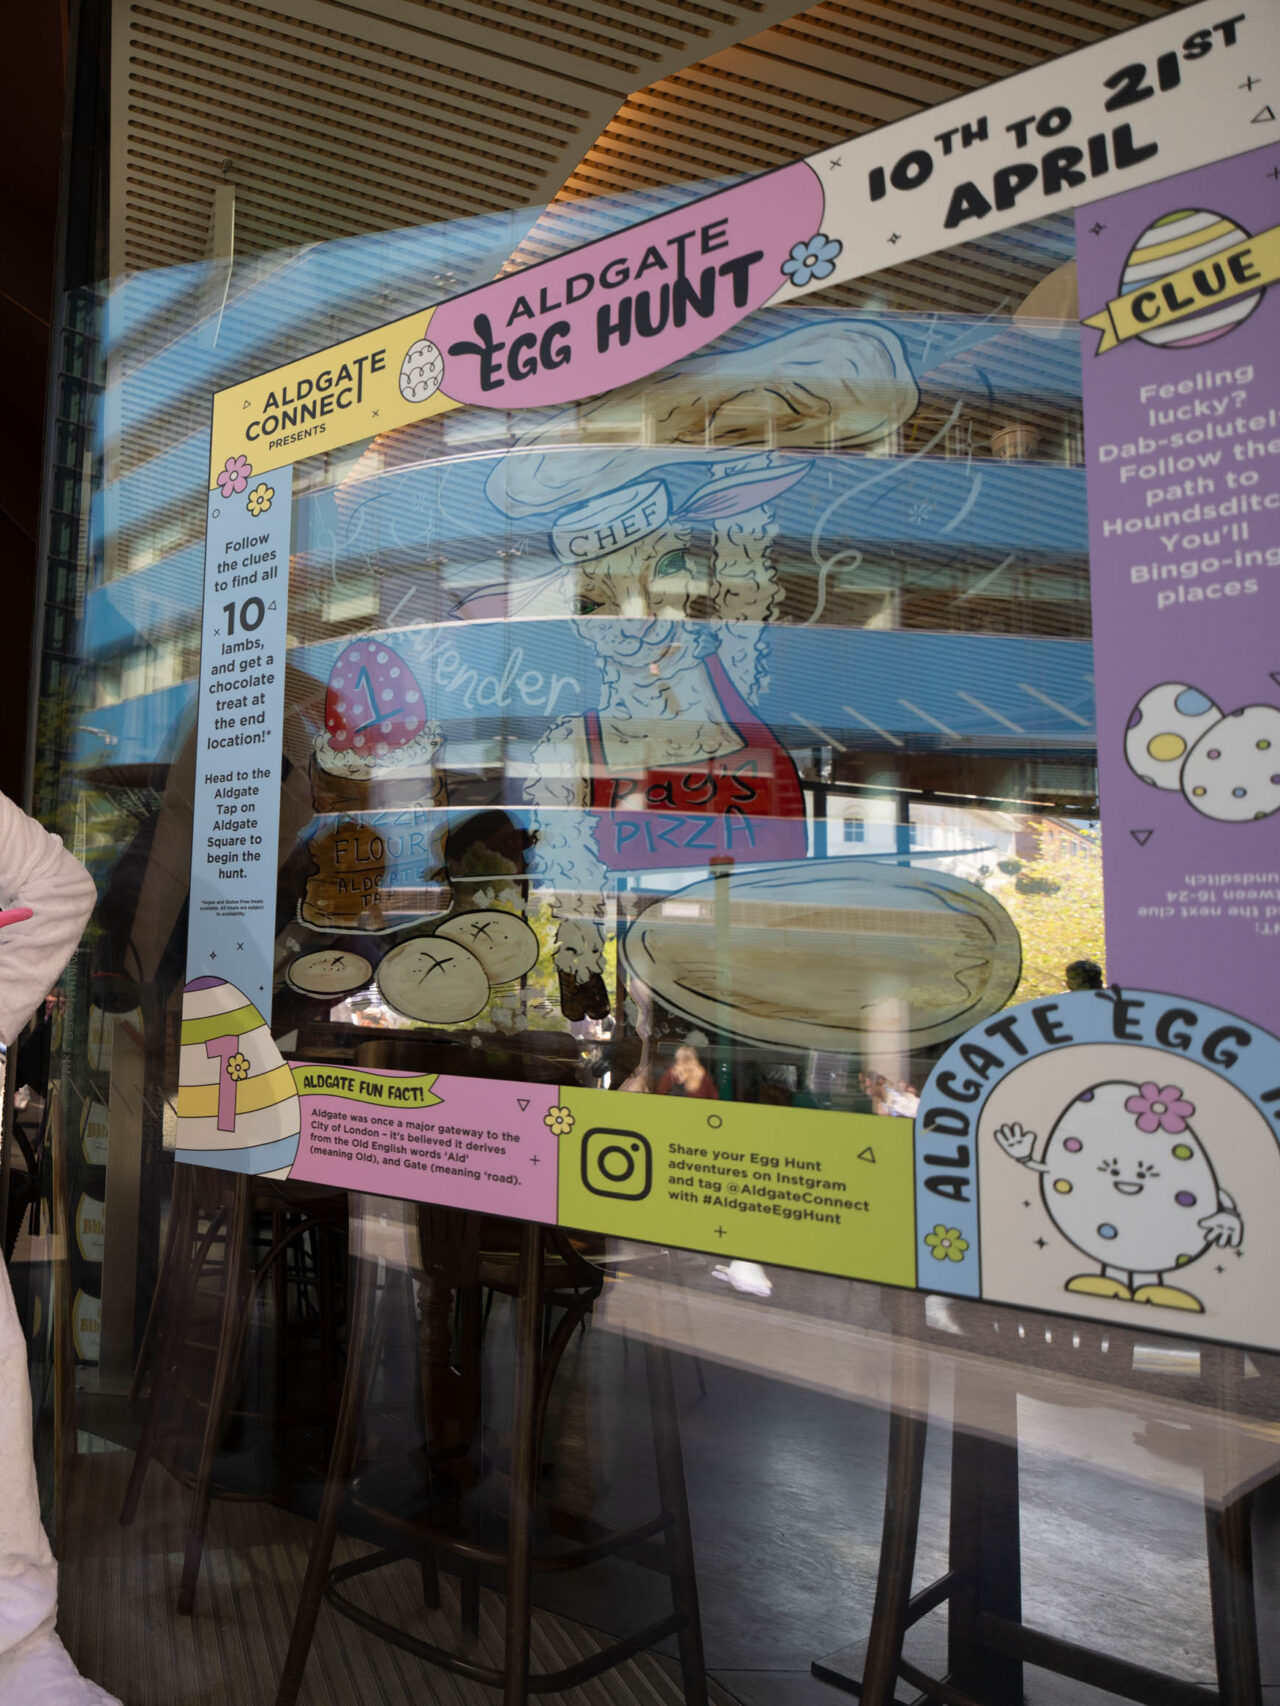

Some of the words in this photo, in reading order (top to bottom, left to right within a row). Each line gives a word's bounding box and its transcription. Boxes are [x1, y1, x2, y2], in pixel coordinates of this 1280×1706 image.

[869, 117, 988, 201] 10TH
[1006, 106, 1072, 149] TO
[1104, 14, 1247, 111] 21ST
[944, 123, 1158, 228] APRIL
[506, 218, 739, 327] ALDGATE
[1131, 249, 1261, 326] CLUE
[460, 314, 572, 392] EGG
[596, 250, 764, 353] HUNT
[263, 349, 386, 413] ALDGATE
[1140, 365, 1254, 403] Feeling
[245, 386, 363, 441] CONNECT
[1149, 390, 1247, 427] lucky?
[268, 423, 326, 450] PRESENTS
[1098, 409, 1280, 462] Dab-solutel
[1119, 451, 1222, 483] Follow
[1146, 476, 1215, 507] path
[1225, 470, 1259, 489] to
[569, 501, 657, 557] CHEF
[1103, 493, 1280, 537] Houndsditc
[225, 532, 270, 554] Follow
[1160, 521, 1249, 552] You'll
[217, 560, 237, 574] the
[242, 549, 277, 568] clues
[214, 579, 228, 592] to
[232, 571, 257, 589] find
[261, 566, 278, 580] all
[1157, 578, 1258, 610] places
[222, 596, 265, 635] 10
[221, 637, 264, 655] lambs,
[211, 660, 235, 676] and
[239, 655, 262, 674] get
[265, 654, 274, 665] a
[209, 673, 275, 694] chocolate
[216, 696, 248, 712] treat
[251, 692, 266, 705] at
[214, 714, 236, 730] the
[239, 711, 265, 727] end
[204, 770, 233, 784] Head
[237, 769, 248, 781] to
[252, 767, 271, 779] the
[214, 785, 259, 800] Aldgate
[213, 818, 258, 832] Aldgate
[217, 803, 237, 816] Tap
[240, 803, 255, 813] on
[207, 836, 246, 849] Square
[250, 834, 262, 845] to
[614, 805, 756, 853] PIZZA
[207, 852, 239, 865] begin
[242, 850, 261, 862] the
[334, 832, 428, 864] FLOUR
[218, 868, 247, 879] hunt.
[1184, 873, 1280, 886] undsditch
[1137, 906, 1175, 918] clue
[1181, 906, 1222, 918] next
[1228, 906, 1259, 917] the
[303, 1074, 355, 1093] ALDGATE
[359, 1080, 383, 1099] FUN
[388, 1085, 424, 1102] FACT!
[923, 1003, 1073, 1203] ALDGATE
[1104, 990, 1252, 1069] EGG
[311, 1108, 347, 1122] Aldgate
[350, 1115, 368, 1123] was
[371, 1116, 394, 1127] once
[406, 1120, 435, 1133] major
[438, 1125, 483, 1140] gateway
[487, 1130, 498, 1140] to
[501, 1132, 520, 1143] the
[311, 1120, 329, 1132] City
[331, 1123, 341, 1132] of
[343, 1125, 379, 1138] London
[407, 1132, 452, 1148] believed
[455, 1138, 462, 1148] it
[465, 1140, 506, 1155] derives
[310, 1133, 332, 1144] from
[334, 1136, 349, 1146] the
[352, 1138, 369, 1149] Old
[371, 1141, 407, 1155] English
[410, 1147, 441, 1160] words
[668, 1143, 708, 1158] Share
[712, 1150, 745, 1164] your
[749, 1153, 779, 1168] Egg
[784, 1157, 822, 1172] Hunt
[310, 1145, 353, 1162] (meaning
[355, 1151, 380, 1165] Old),
[382, 1156, 400, 1167] and
[403, 1159, 427, 1171] Gate
[430, 1163, 480, 1181] (meaning
[668, 1159, 748, 1179] adventures
[752, 1170, 771, 1181] on
[776, 1172, 847, 1193] Instgram
[668, 1174, 694, 1187] and
[697, 1178, 723, 1193] tag
[726, 1181, 870, 1212] @AldgateConnect
[668, 1189, 698, 1204] with
[702, 1194, 842, 1225] #AldgateEggHunt
